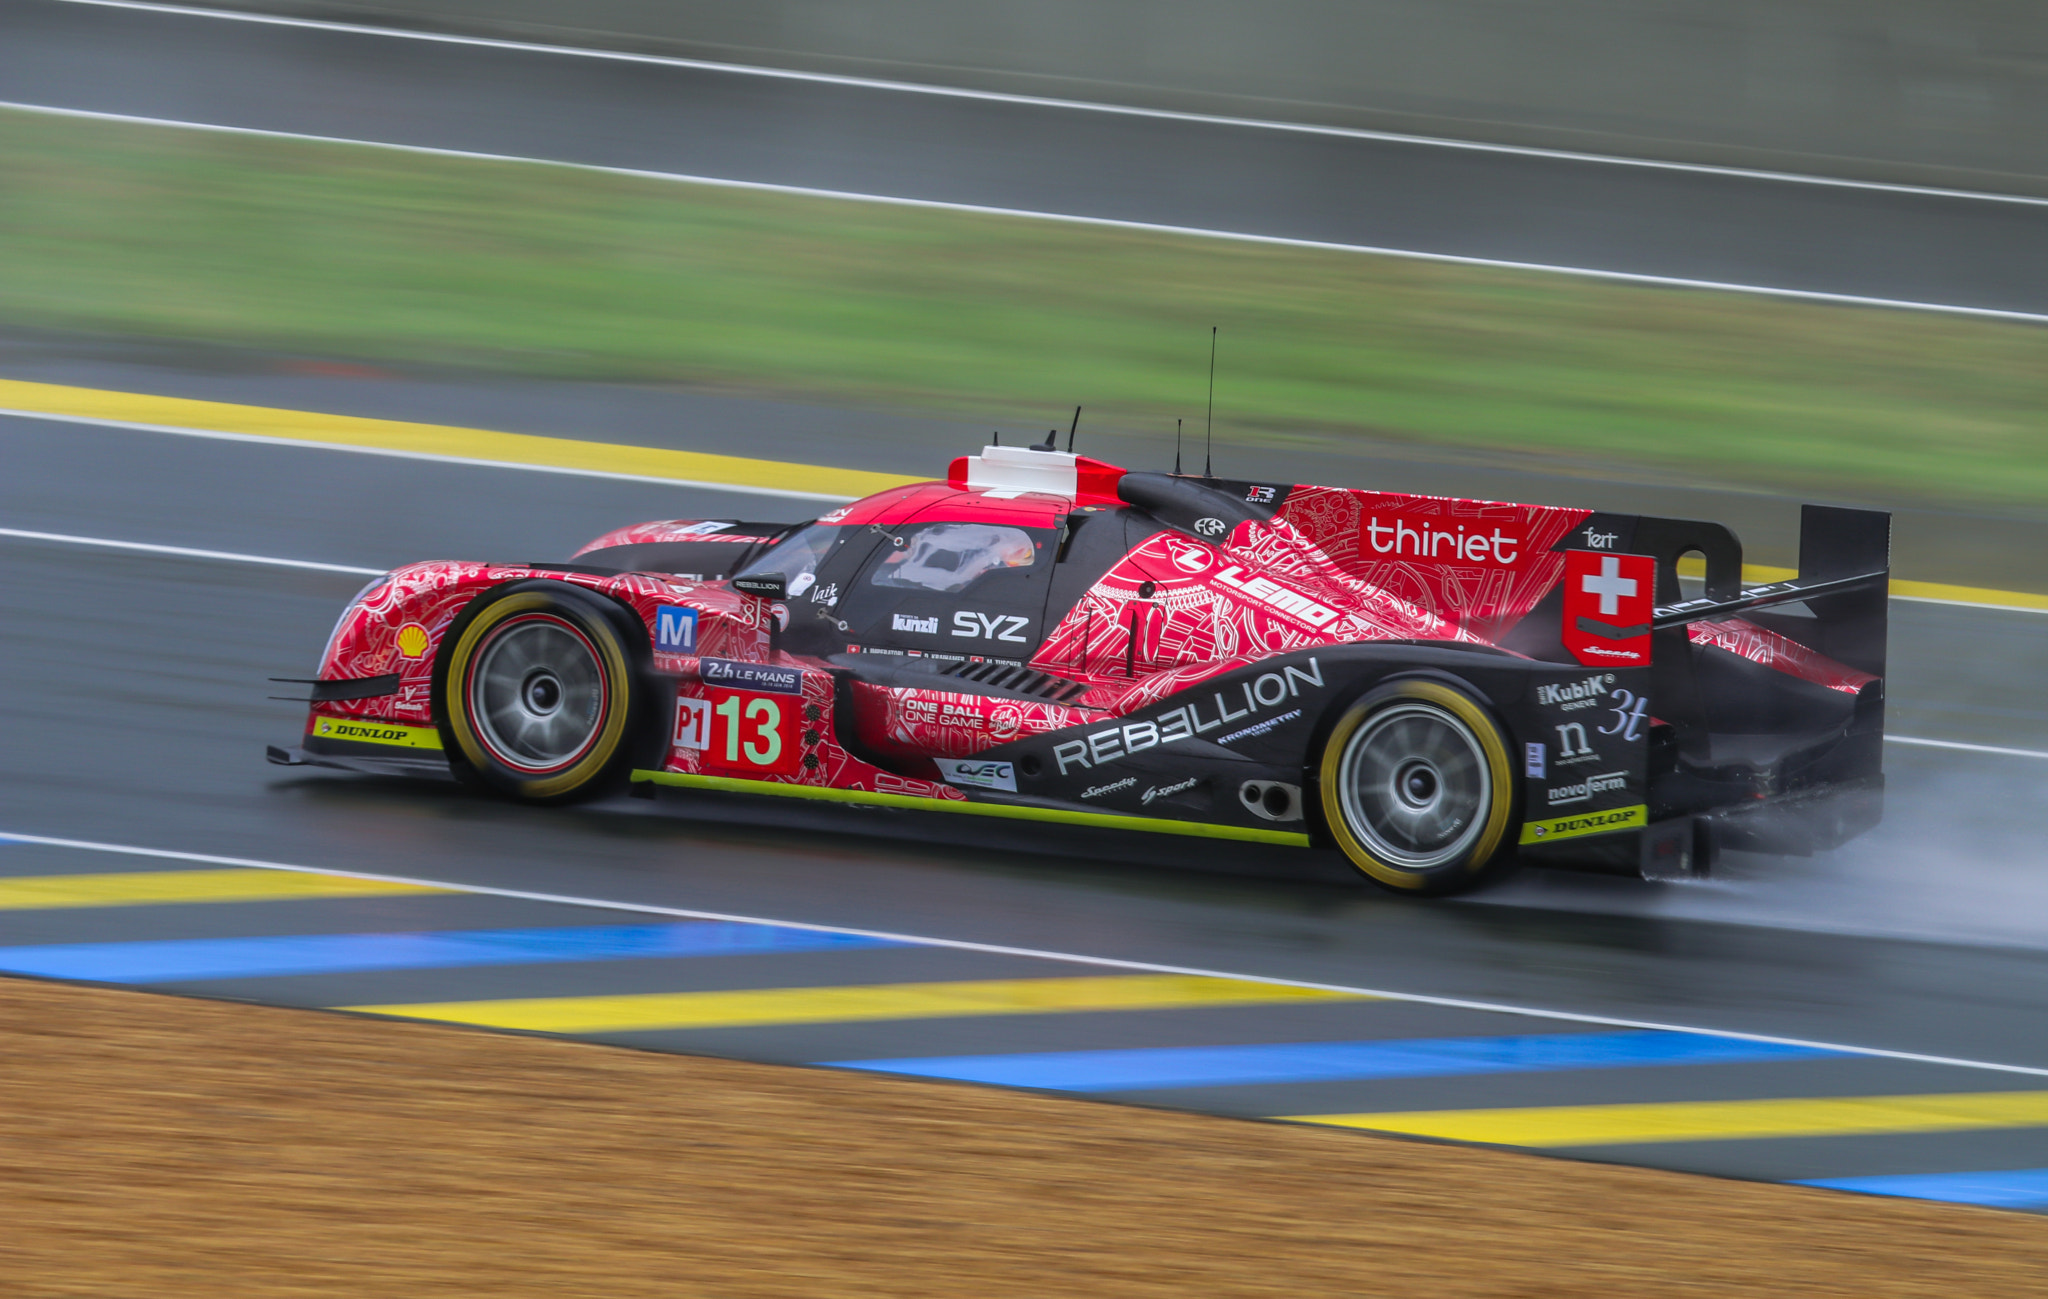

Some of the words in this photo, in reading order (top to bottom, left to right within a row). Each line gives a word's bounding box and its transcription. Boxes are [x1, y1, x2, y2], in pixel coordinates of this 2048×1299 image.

[1367, 516, 1518, 564] thiriet
[1582, 526, 1619, 549] fert
[1209, 578, 1264, 608] MOTORSPORT
[1263, 604, 1317, 634] CONNECTORS
[1213, 565, 1340, 627] LEMO
[660, 613, 693, 647] M
[951, 611, 1030, 643] SYZ
[736, 670, 754, 680] LE
[755, 671, 795, 684] MANS
[677, 704, 704, 743] P1
[905, 710, 936, 724] ONE
[939, 715, 983, 729] GAME
[906, 700, 938, 713] ONE
[943, 704, 984, 718] BALL
[1053, 657, 1325, 776] REBELLION
[334, 725, 408, 740] DUNLOP
[716, 695, 782, 765] 13
[1555, 721, 1594, 758] n
[1080, 777, 1137, 799] Speedy
[1548, 774, 1627, 804] novoferm
[1553, 810, 1637, 833] DUNLOP
